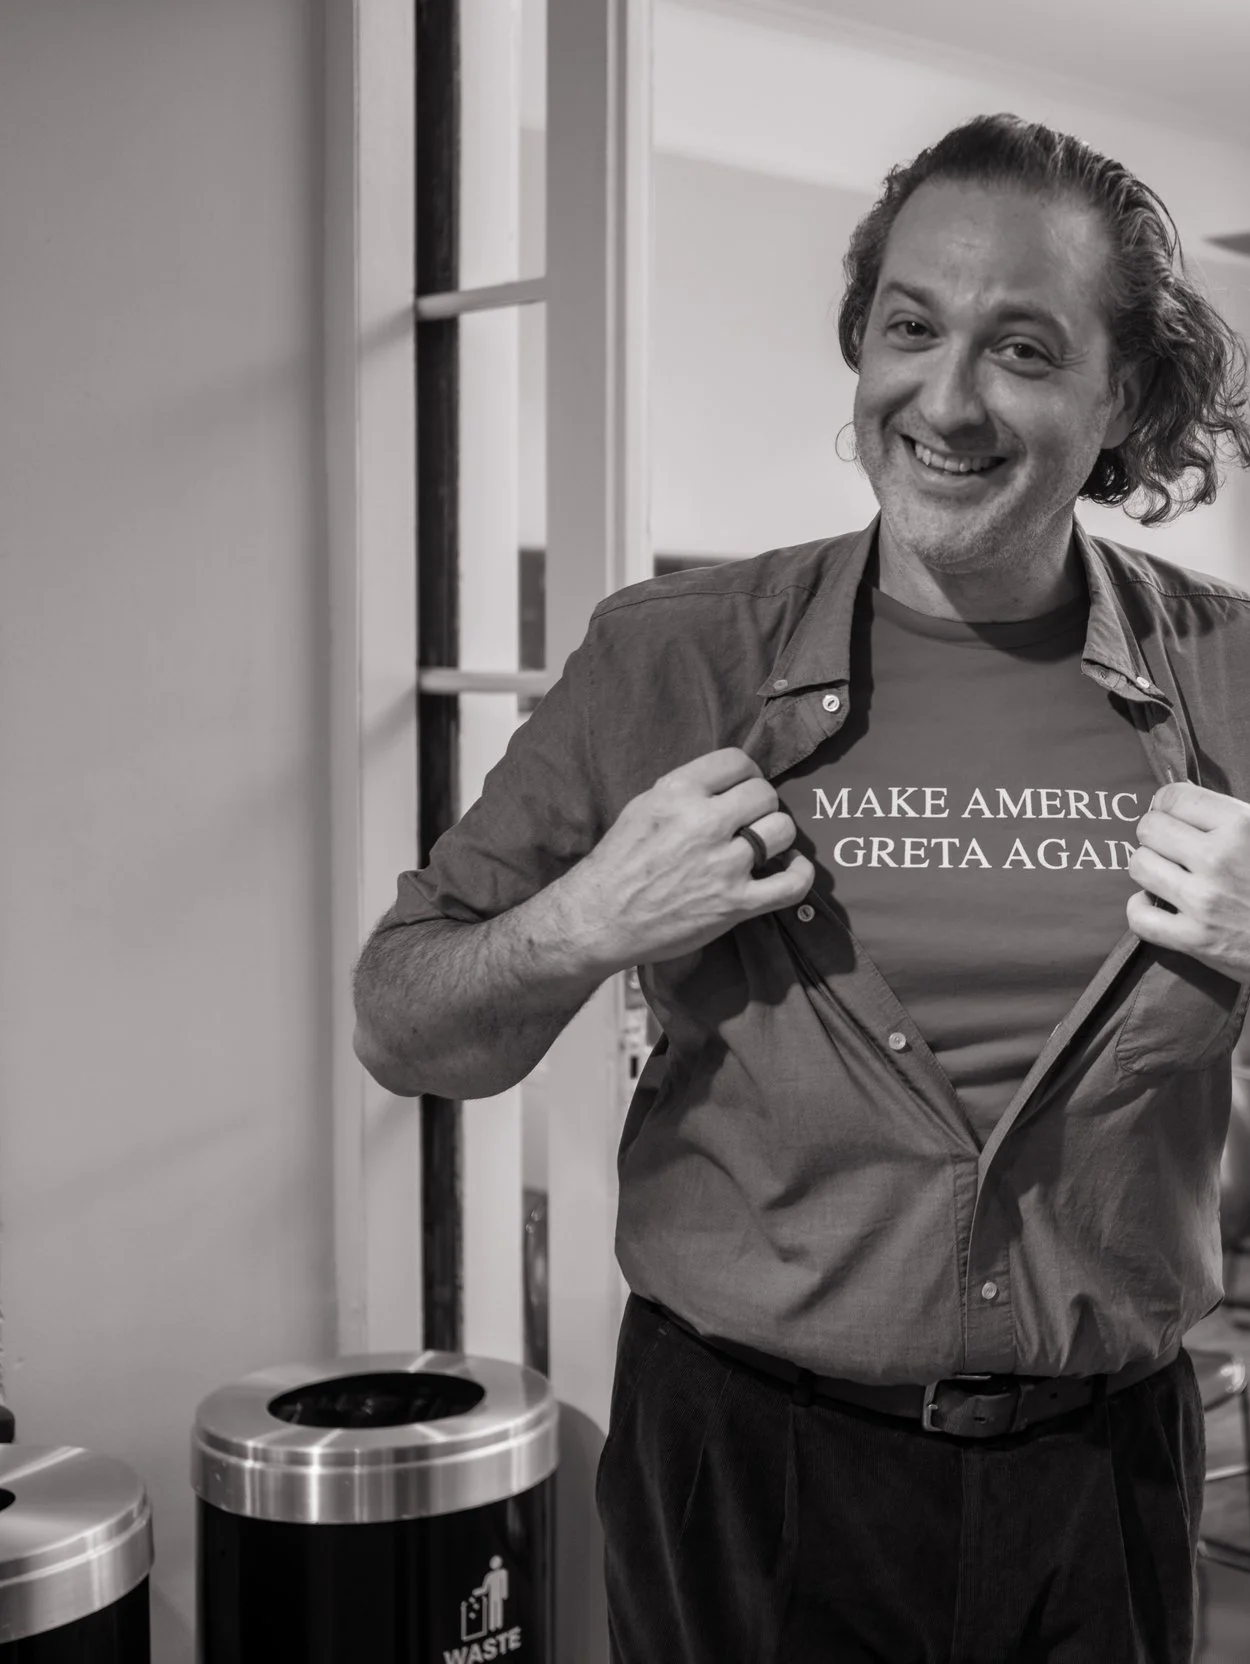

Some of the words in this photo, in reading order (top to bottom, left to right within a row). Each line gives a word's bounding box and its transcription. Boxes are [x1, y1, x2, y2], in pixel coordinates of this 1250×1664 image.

[811, 787, 949, 819] MAKE
[961, 787, 1155, 822] AMERIC
[833, 836, 992, 868] GRETA
[443, 1626, 522, 1664] WASTE
